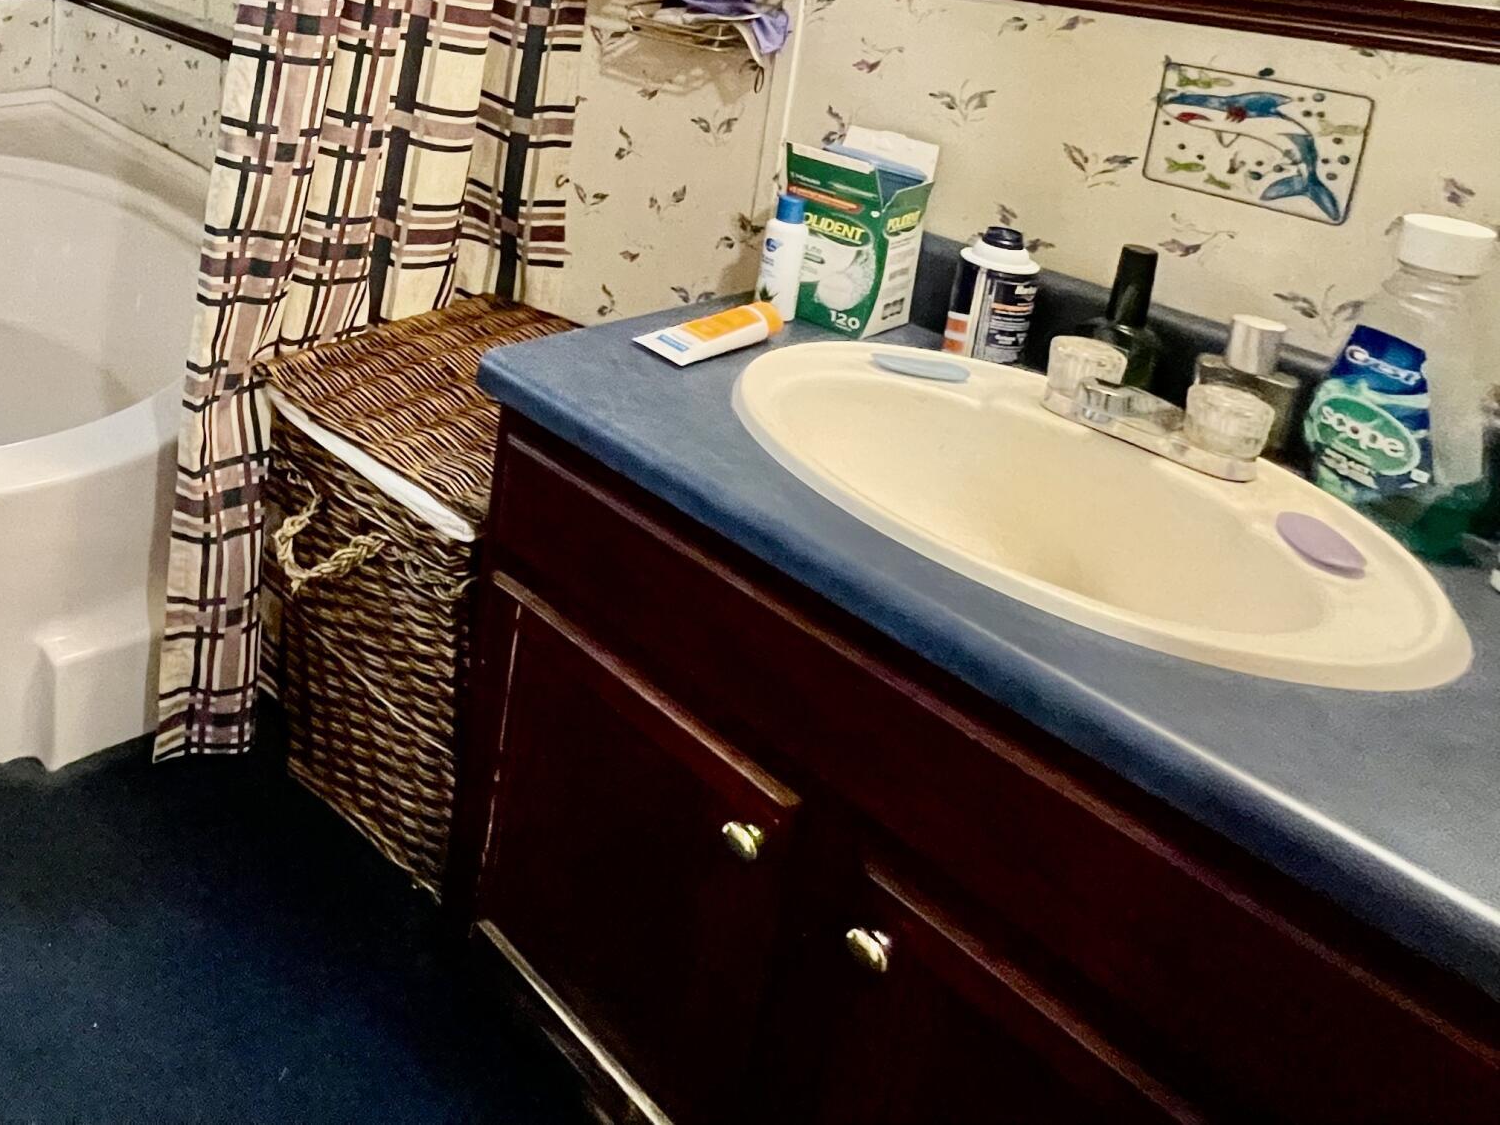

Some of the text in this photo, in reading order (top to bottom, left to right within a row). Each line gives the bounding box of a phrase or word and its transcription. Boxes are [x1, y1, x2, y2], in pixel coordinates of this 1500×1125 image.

[804, 212, 865, 242] OLIDENT
[830, 309, 860, 330] 120
[1345, 345, 1421, 385] Crest
